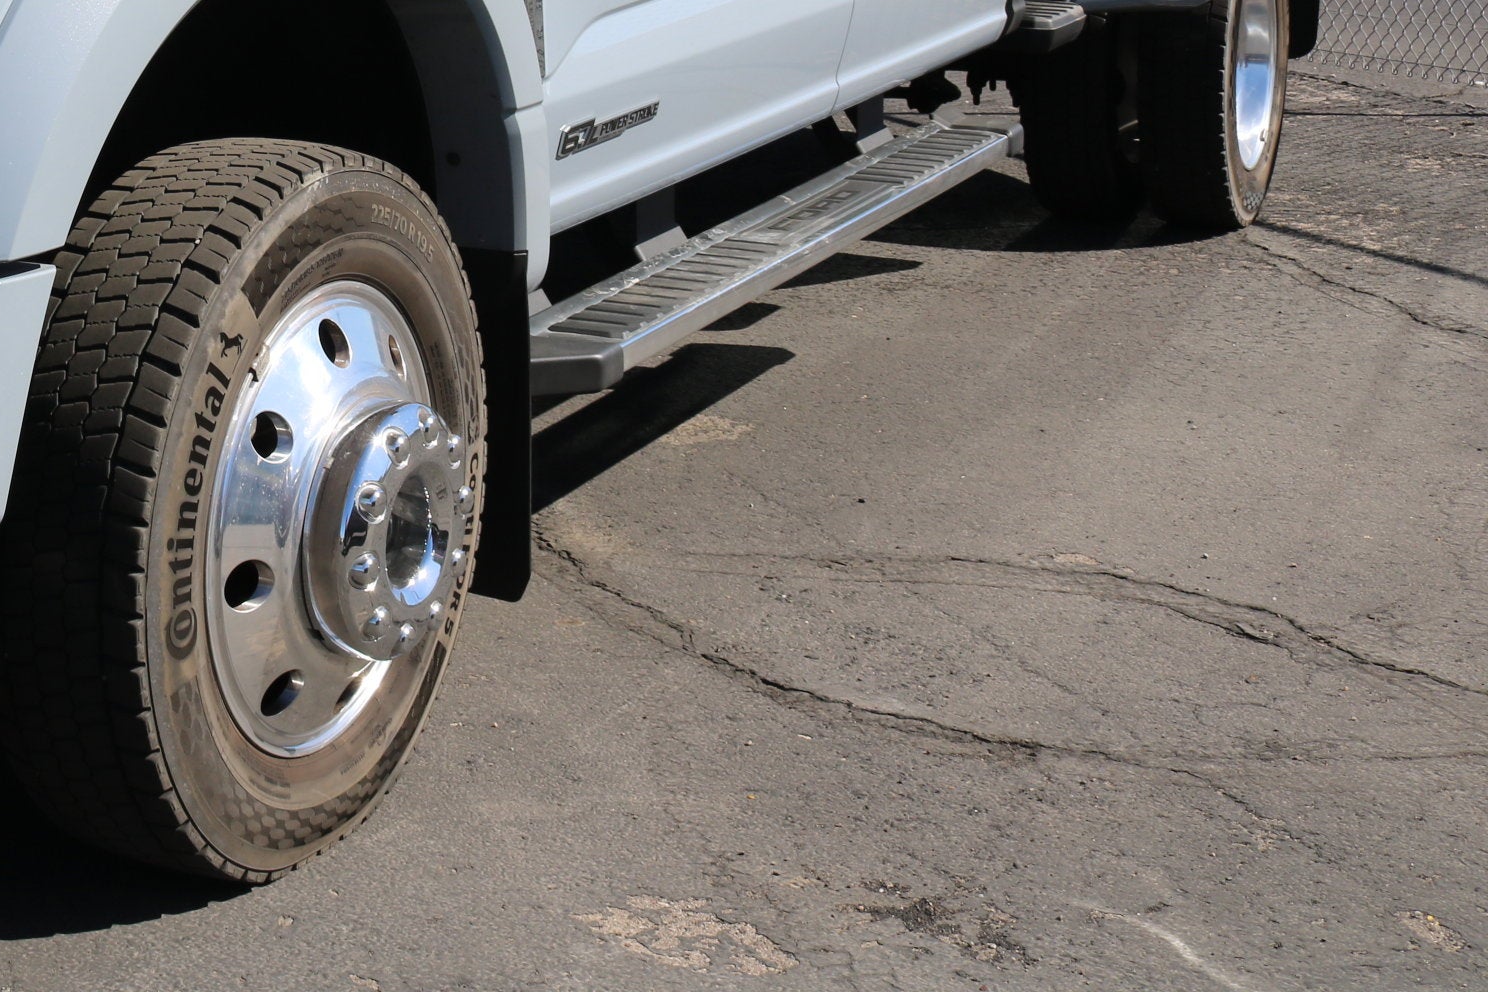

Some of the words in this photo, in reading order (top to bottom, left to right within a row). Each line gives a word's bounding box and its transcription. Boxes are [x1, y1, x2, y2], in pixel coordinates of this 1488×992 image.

[599, 114, 629, 137] POWER
[628, 102, 660, 126] STROKE
[371, 203, 408, 235] 225/70
[407, 222, 417, 244] R
[416, 230, 435, 264] 19.5
[767, 190, 862, 232] FORD
[165, 361, 233, 661] Continental
[464, 452, 480, 536] Coti
